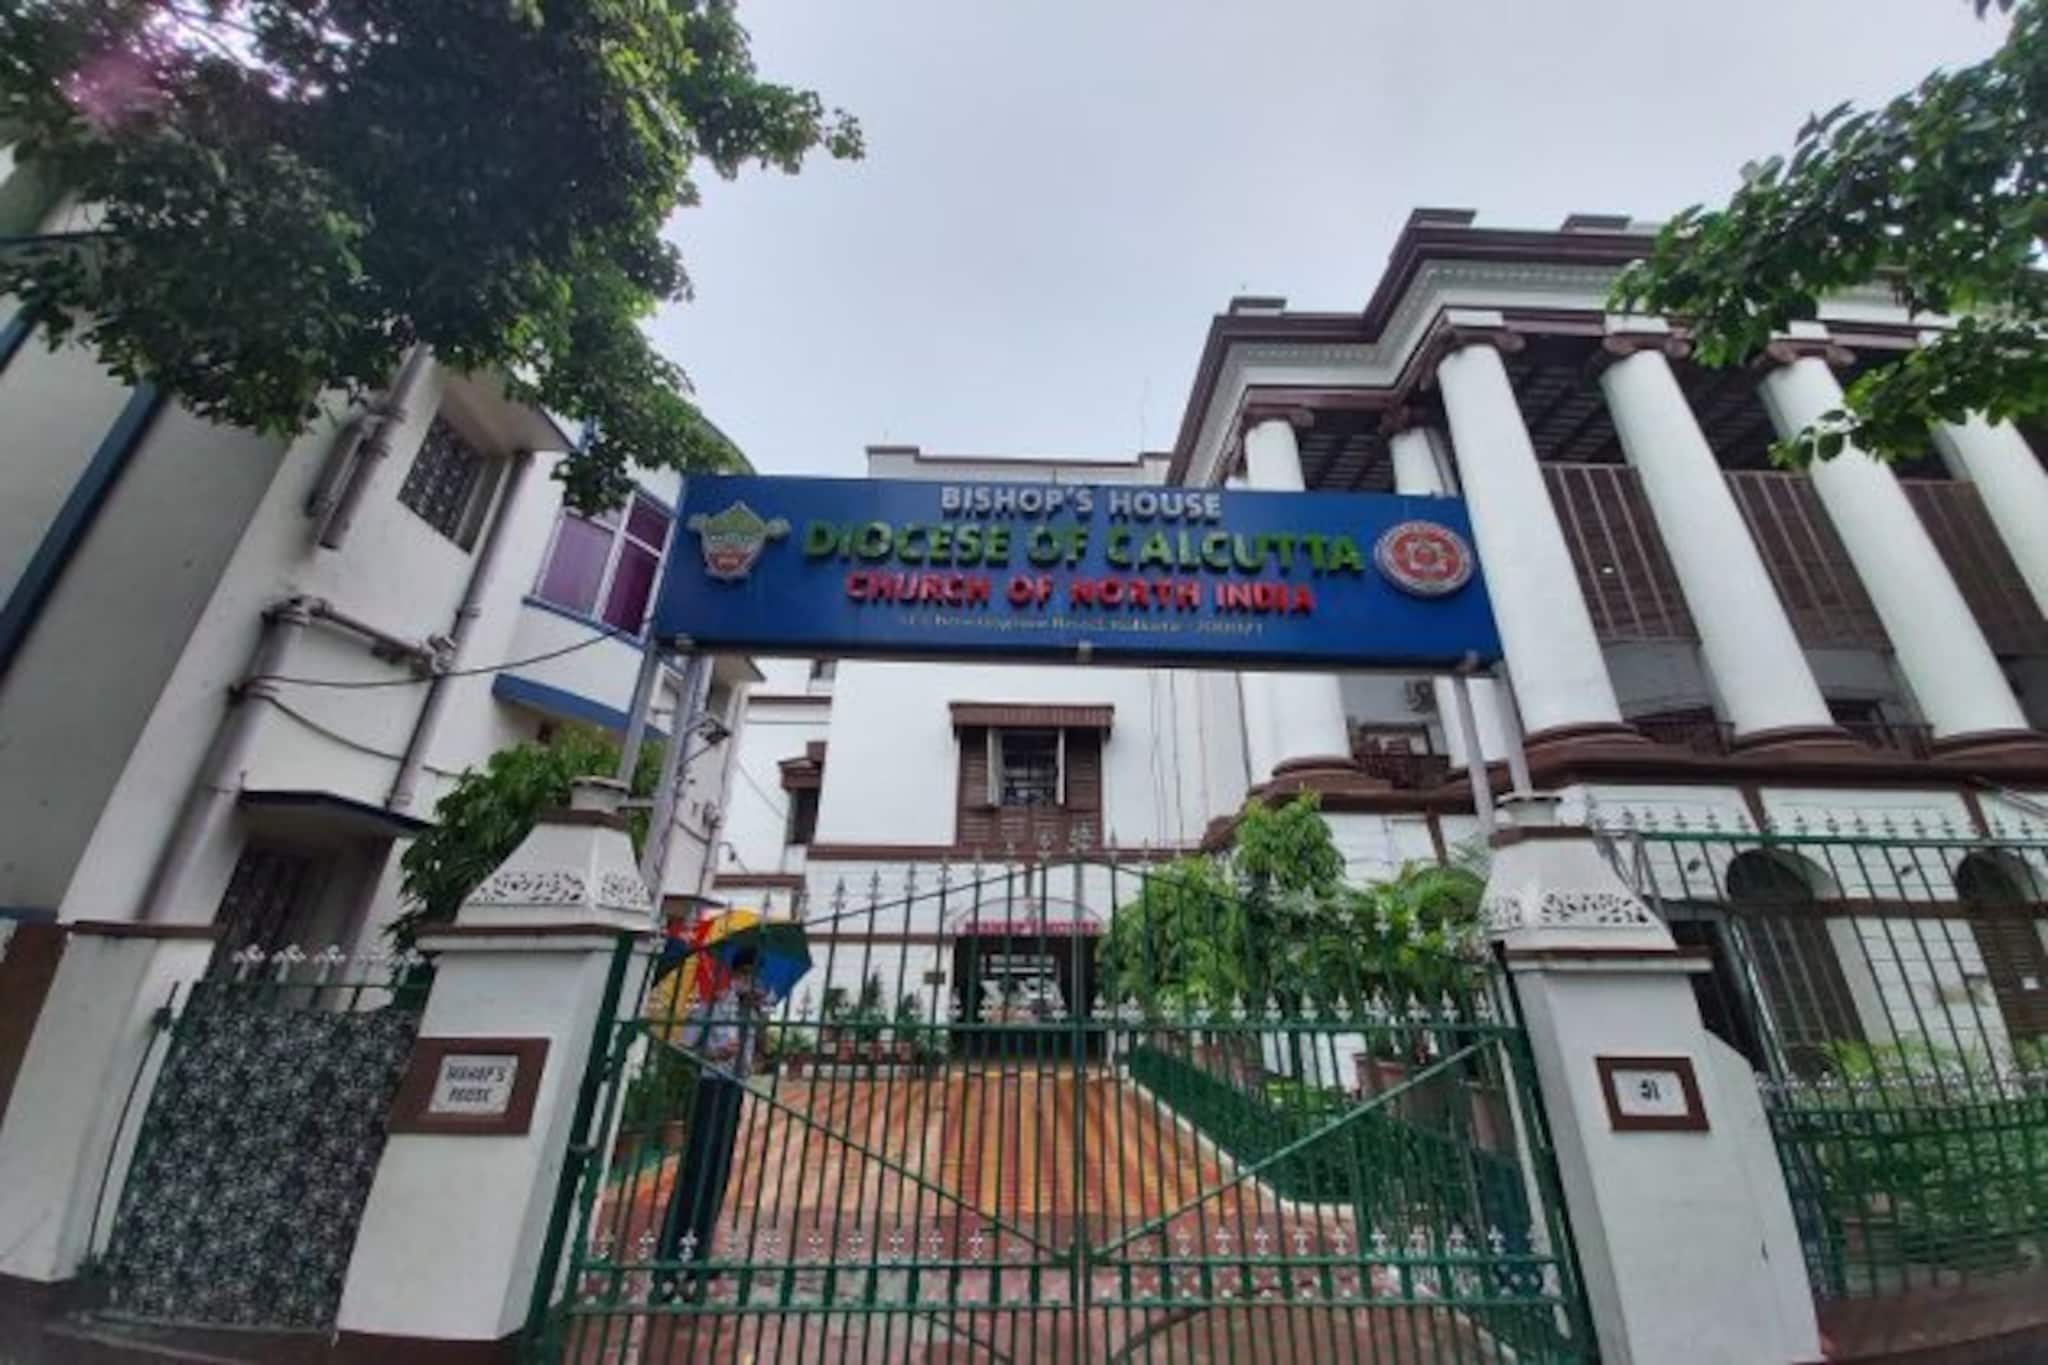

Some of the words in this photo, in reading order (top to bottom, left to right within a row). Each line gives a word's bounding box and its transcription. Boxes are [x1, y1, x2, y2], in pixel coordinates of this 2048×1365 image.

[940, 485, 1093, 513] BISHOP'S
[1108, 490, 1223, 519] HOUSE
[803, 519, 1011, 563] DIOCESE
[1028, 523, 1090, 565] OF
[1105, 526, 1366, 574] CALCUTTA
[845, 571, 992, 604] CHURCH
[1008, 573, 1053, 606] OF
[1070, 576, 1200, 610] NORTH
[1213, 581, 1317, 614] INDIA
